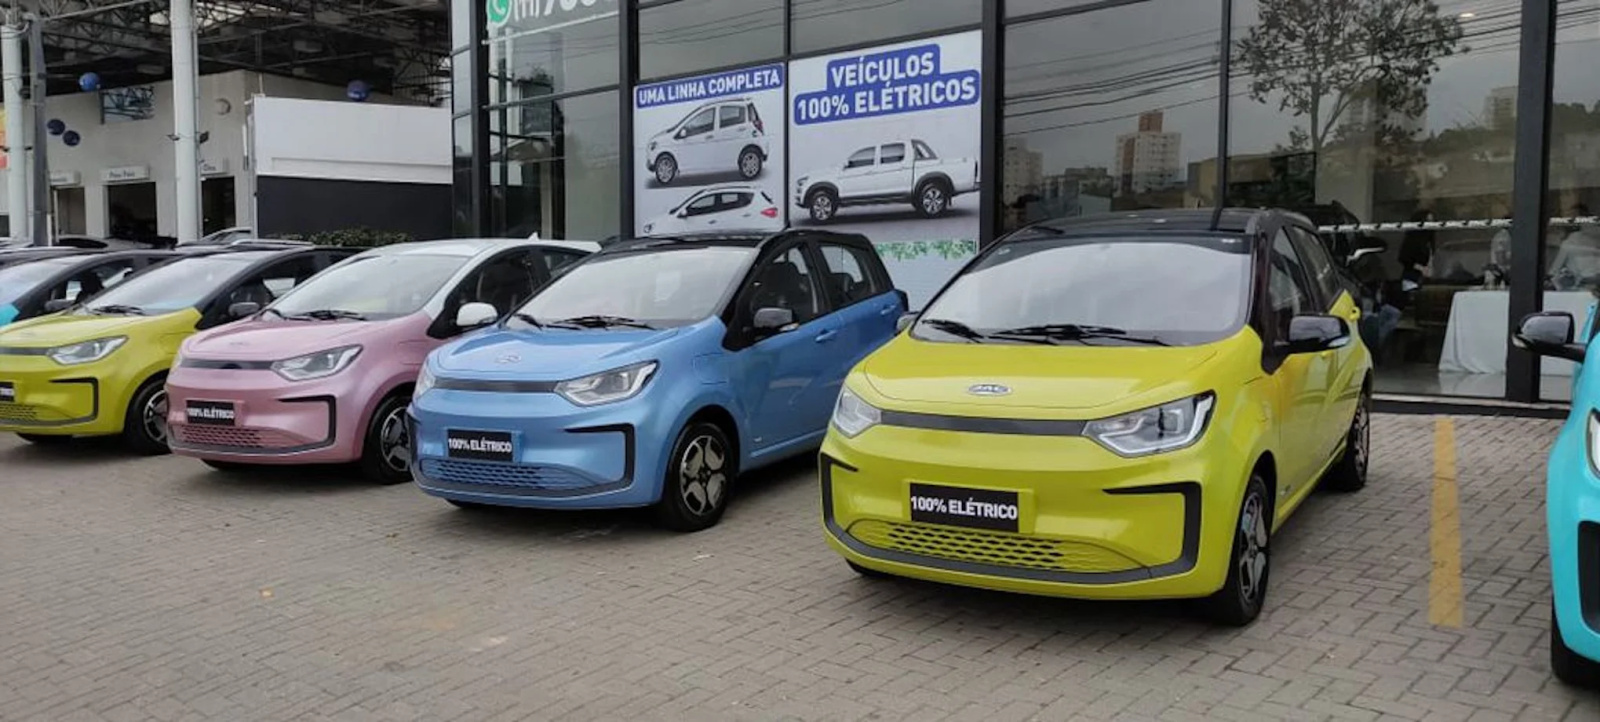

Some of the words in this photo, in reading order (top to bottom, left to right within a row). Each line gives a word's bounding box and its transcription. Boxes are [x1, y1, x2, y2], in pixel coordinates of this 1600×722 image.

[638, 87, 666, 105] UMA
[667, 81, 707, 101] LINHA
[707, 69, 781, 94] COMPLETA
[830, 52, 935, 88] VEÍCULOS
[797, 94, 848, 121] 100%
[854, 77, 976, 115] ELÉTRICOS
[448, 438, 470, 449] 100%
[470, 437, 512, 453] ELÉTRICO
[911, 496, 947, 512] 100%
[948, 497, 1018, 520] ELÉTRICO
